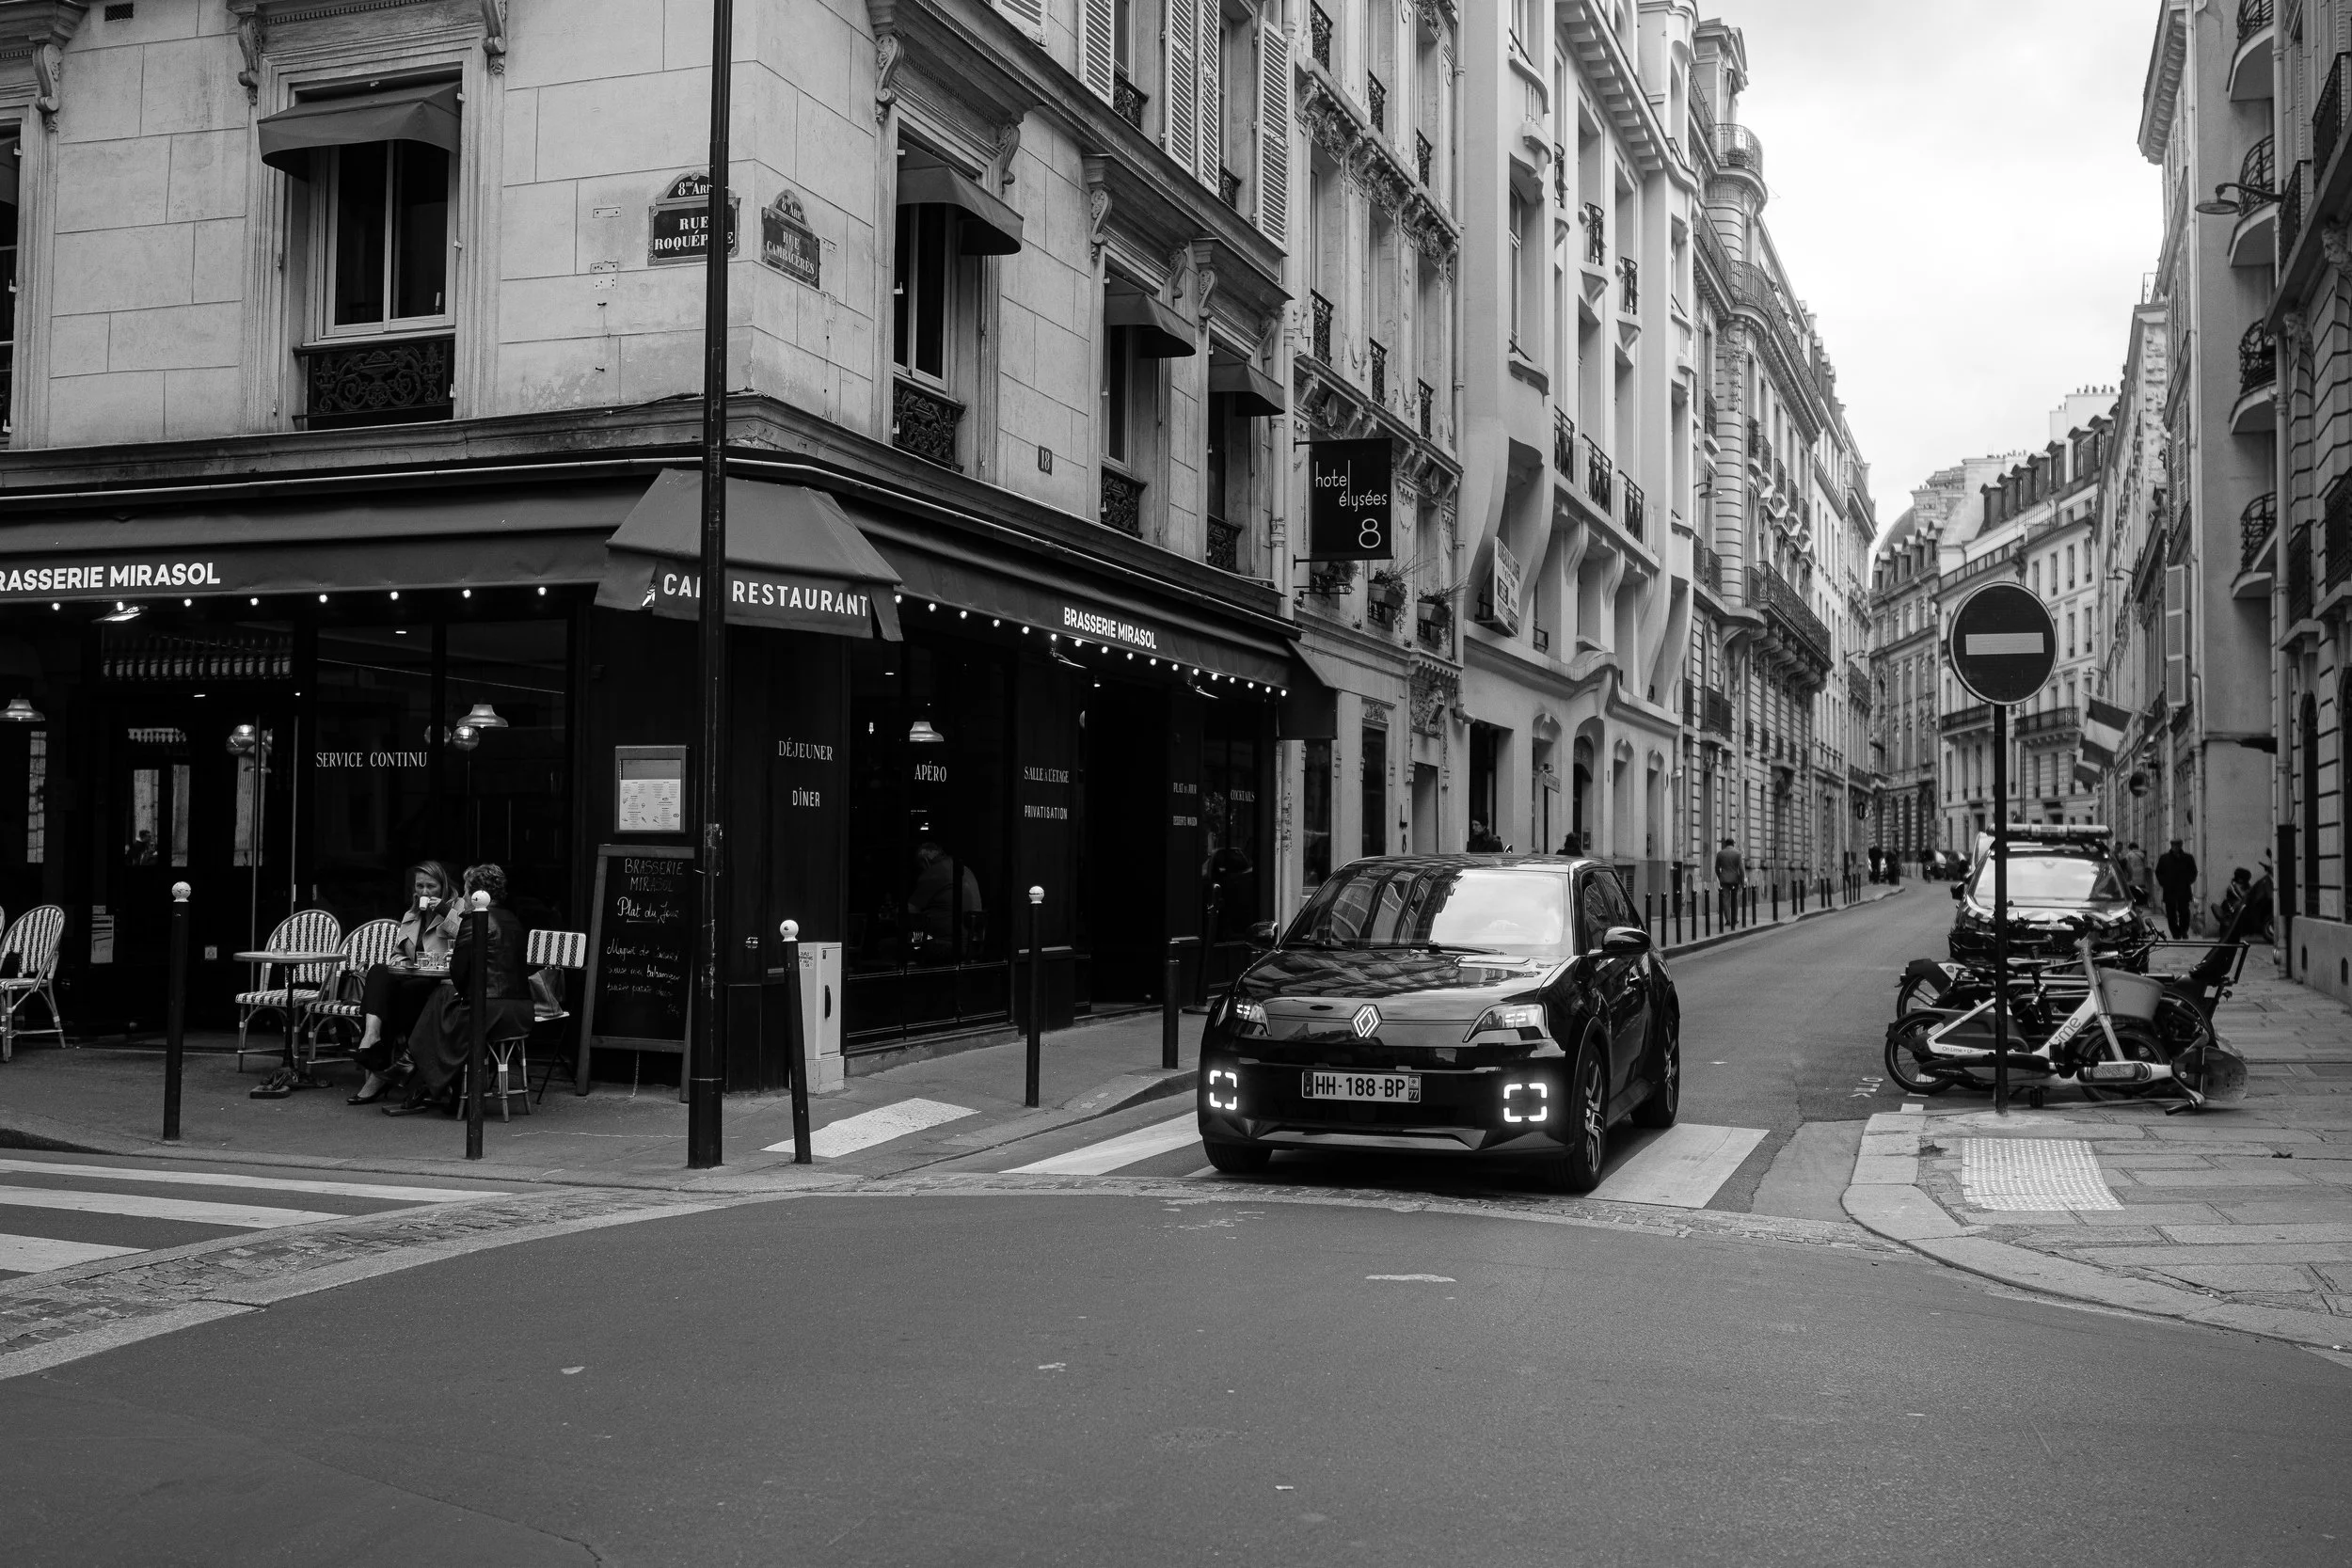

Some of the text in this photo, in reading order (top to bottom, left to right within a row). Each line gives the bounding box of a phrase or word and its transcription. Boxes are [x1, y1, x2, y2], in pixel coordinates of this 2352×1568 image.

[679, 215, 709, 230] RUE
[654, 230, 734, 250] ROQUÉPE
[783, 230, 800, 250] RUE
[767, 240, 815, 275] CAMBACÉRÈS
[1041, 450, 1051, 471] 18
[1315, 460, 1351, 490] hotel
[1339, 488, 1388, 513] élysées
[1359, 518, 1381, 548] 8
[109, 562, 221, 588] MIRASOL
[663, 573, 867, 617] CA RESTAURANT
[1064, 607, 1157, 650] BRASSERIE MIRASOL
[315, 752, 427, 768] SERVICE CONTINU
[778, 736, 834, 762] DÉJEUNER
[914, 760, 947, 783] APÉRO
[1024, 766, 1044, 782] SALLE
[792, 786, 820, 807] DÎNER
[1230, 789, 1255, 802] COCKTAILS
[1024, 804, 1068, 820] PRIVATISATION
[625, 857, 684, 876] BRASSERIE
[629, 876, 674, 893] MIRASOL
[617, 895, 642, 918] Plat
[644, 902, 657, 918] du
[2049, 1017, 2082, 1044] ime
[1315, 1075, 1406, 1099] HH-188-BP
[1408, 1089, 1419, 1100] 77
